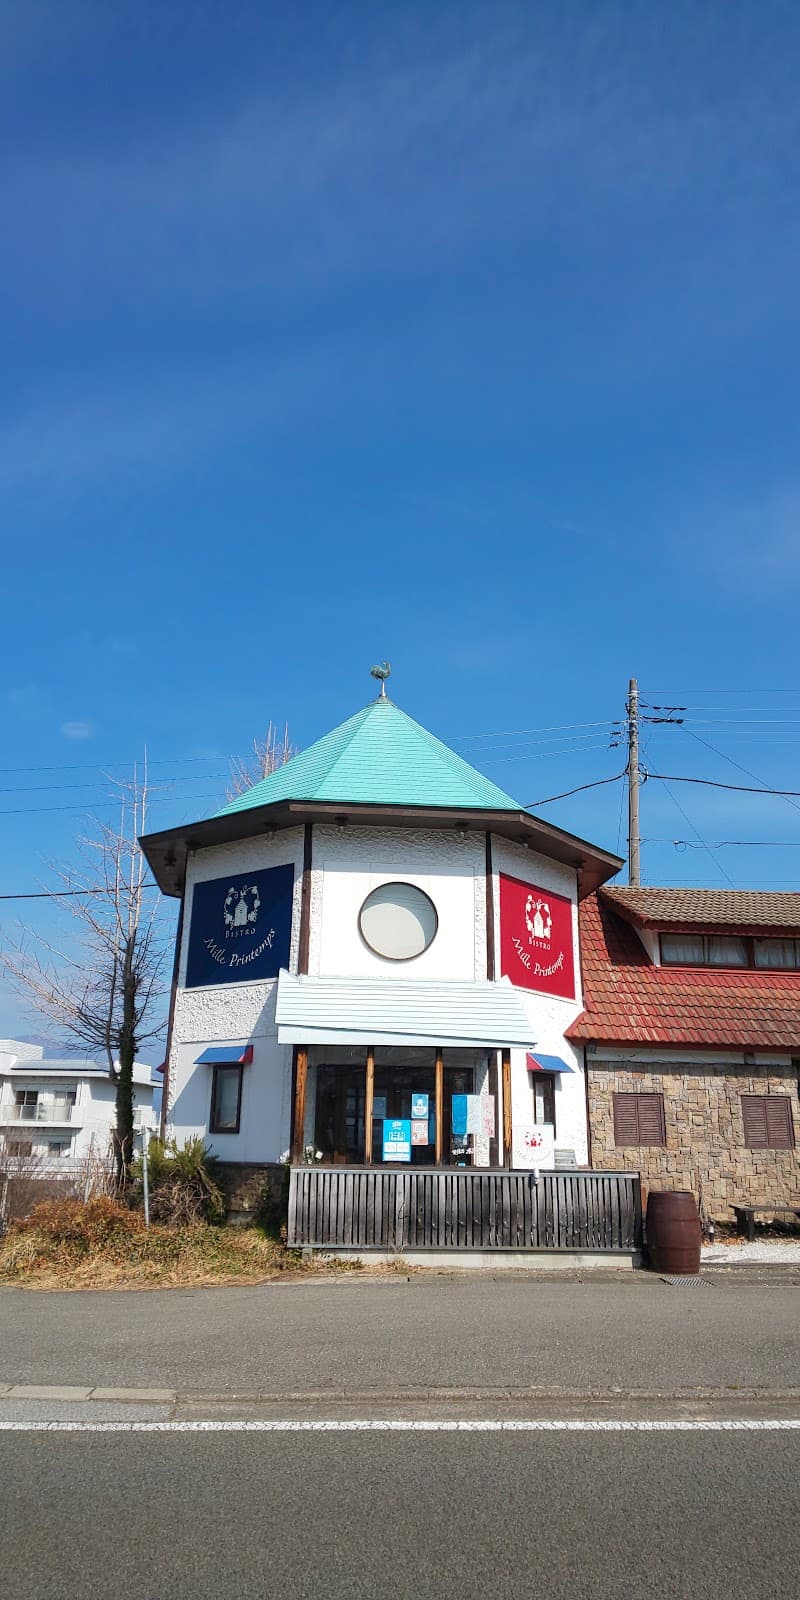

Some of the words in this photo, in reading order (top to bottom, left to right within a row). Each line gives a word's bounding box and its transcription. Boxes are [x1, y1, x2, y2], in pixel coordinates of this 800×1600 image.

[225, 928, 256, 938] BISTRO
[528, 937, 551, 950] BISTRO
[203, 937, 226, 965] Mille
[229, 928, 276, 966] Printemps
[511, 937, 531, 970] Mille
[534, 952, 565, 977] Printemps
